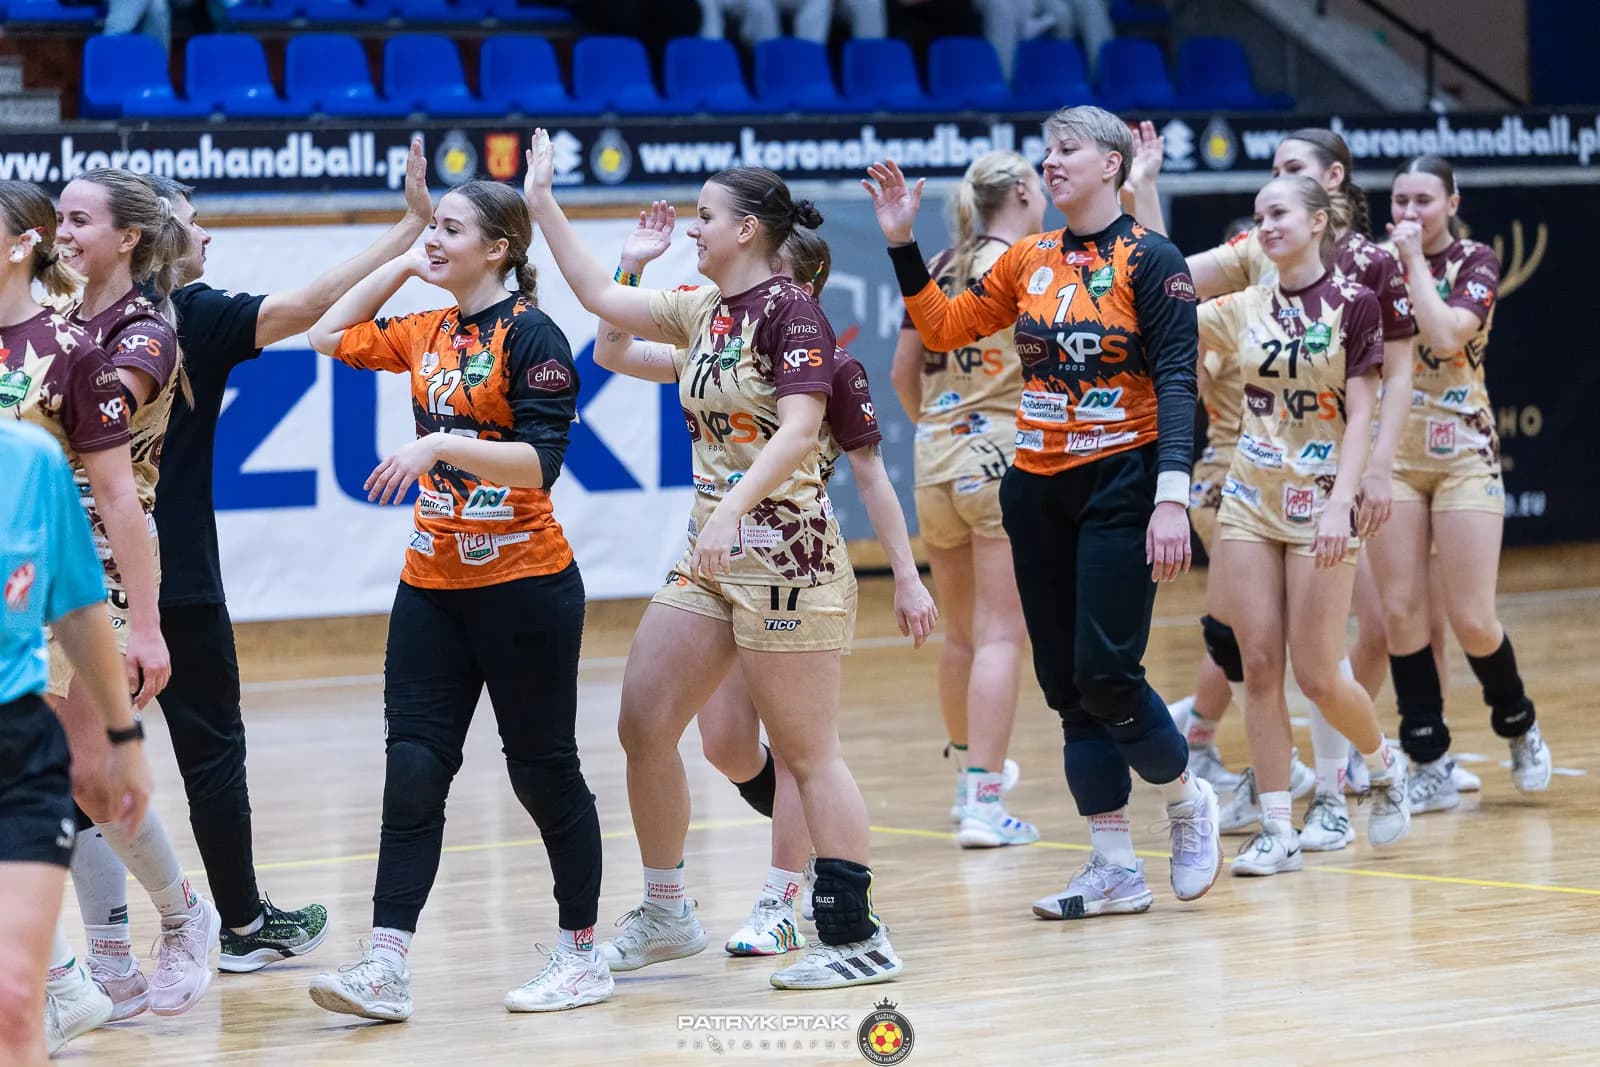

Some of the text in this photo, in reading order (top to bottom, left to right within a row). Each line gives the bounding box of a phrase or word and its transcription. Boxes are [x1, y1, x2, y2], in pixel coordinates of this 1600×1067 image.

[1053, 283, 1078, 323] 1
[784, 348, 823, 370] KPS
[952, 347, 1004, 377] KPS
[1057, 332, 1128, 364] KPS
[1258, 339, 1301, 379] 21
[1058, 364, 1086, 372] FOOD
[427, 368, 463, 417] 12
[1281, 388, 1338, 422] KPS
[700, 410, 758, 443] KPS
[770, 586, 800, 611] 17
[764, 619, 797, 631] TICO
